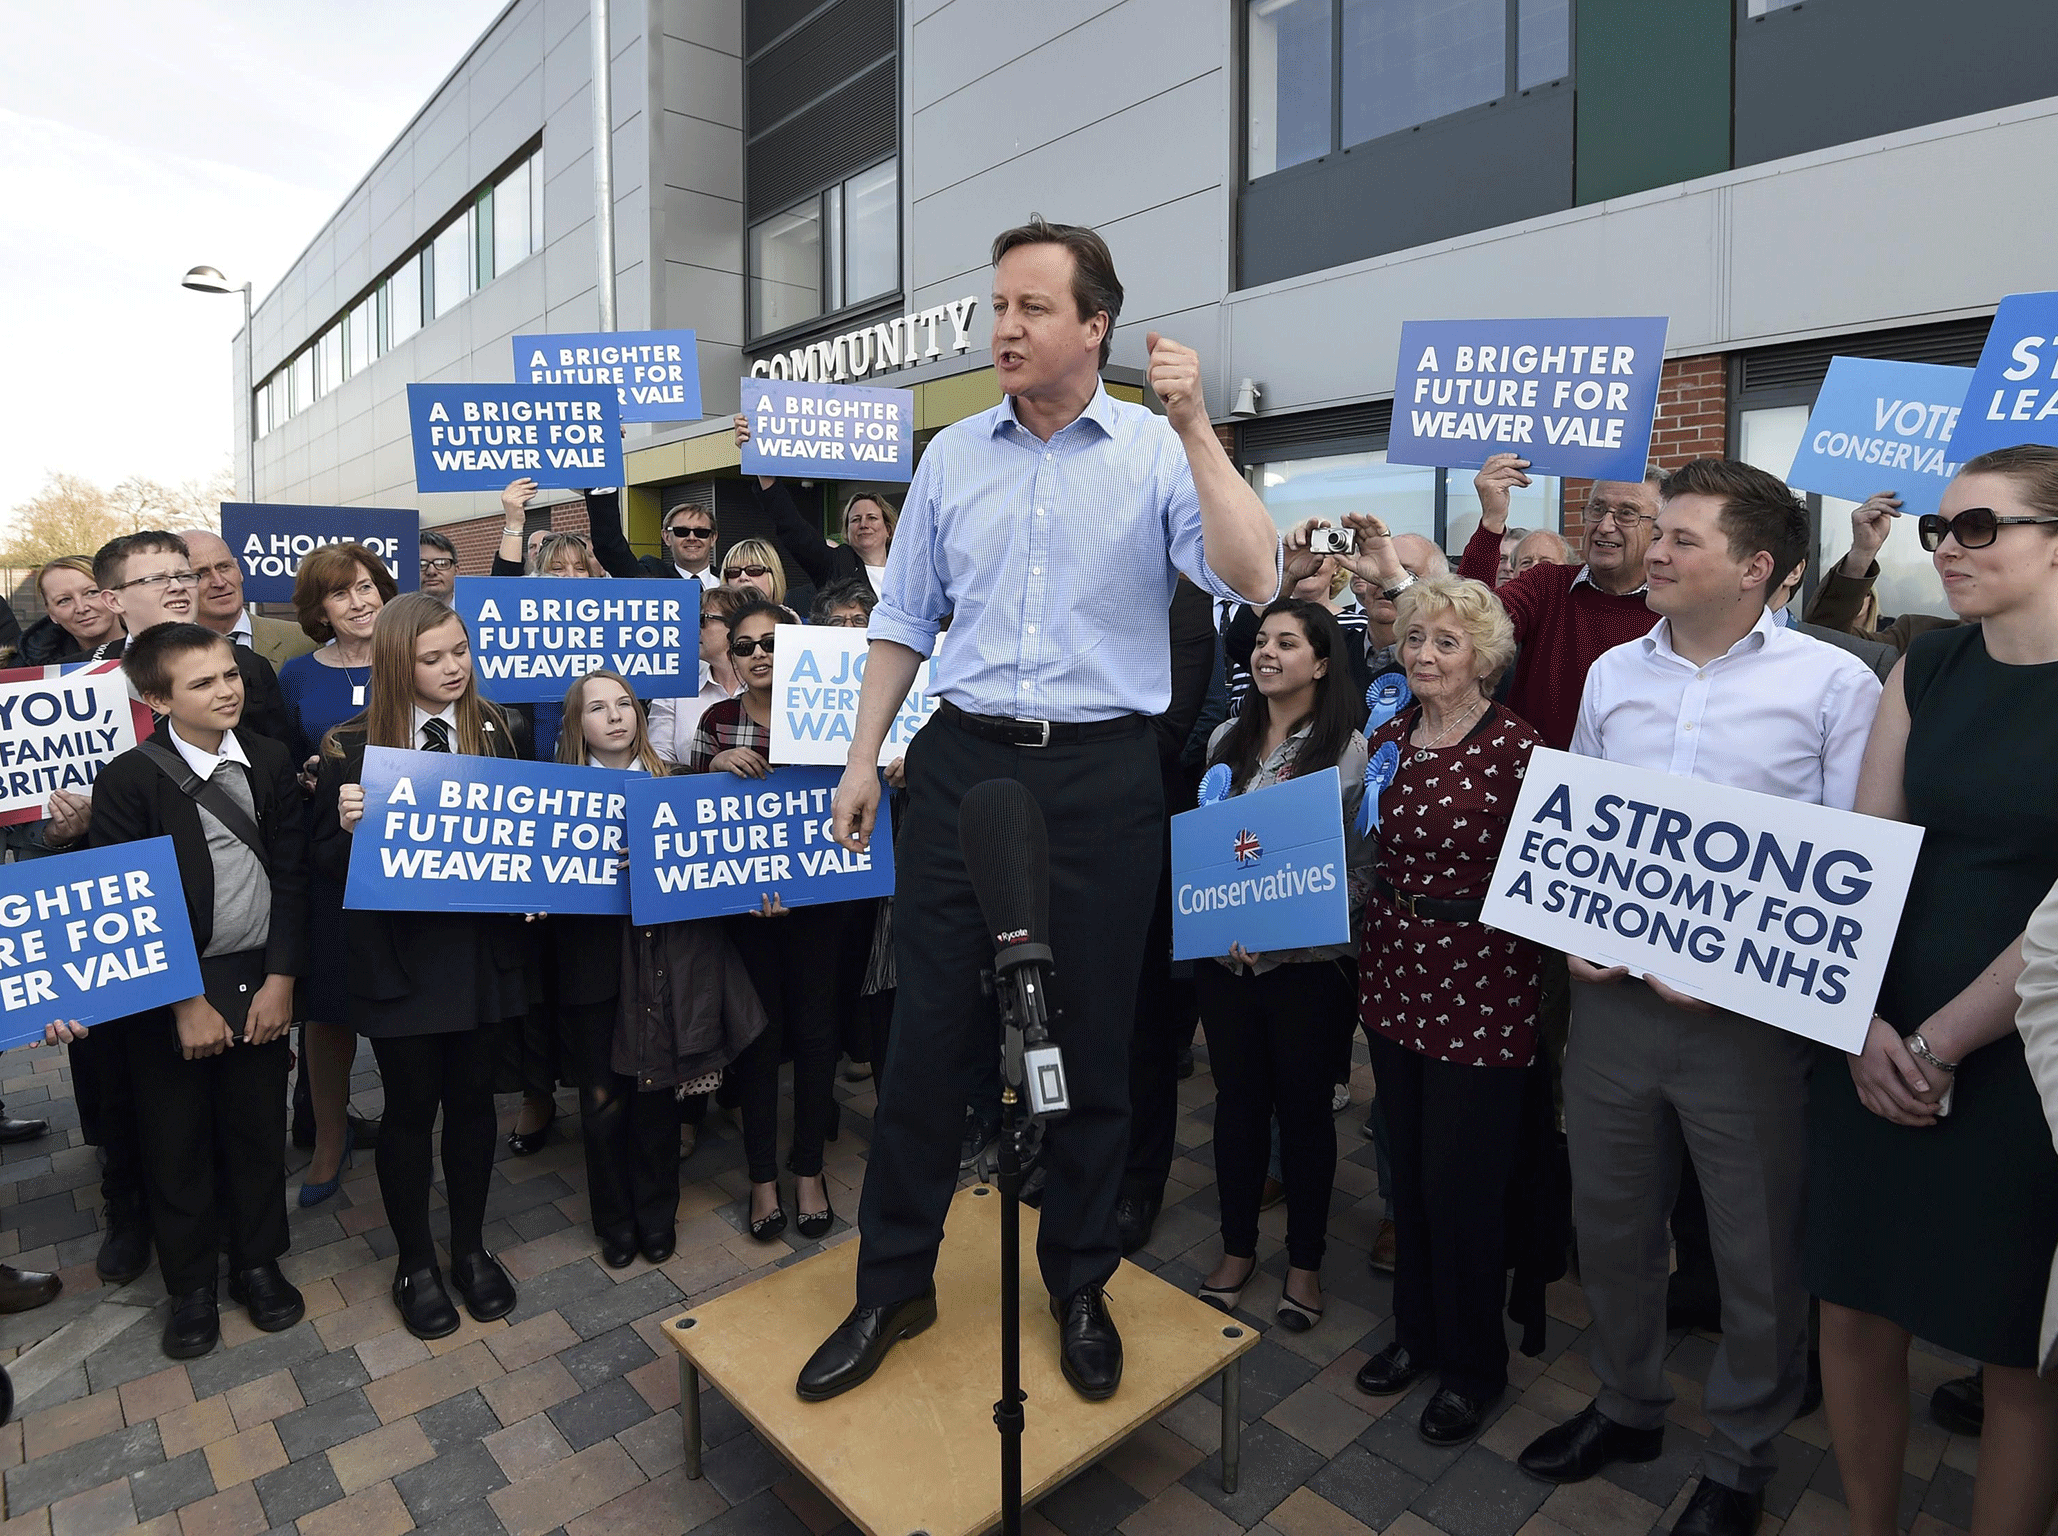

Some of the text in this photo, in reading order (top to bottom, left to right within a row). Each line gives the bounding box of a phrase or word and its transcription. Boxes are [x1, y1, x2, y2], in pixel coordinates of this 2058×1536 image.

[530, 345, 682, 367] A BRIGHTER
[751, 296, 978, 383] COMMUNITY
[532, 365, 683, 384] FUTURE FOR
[1417, 345, 1635, 375] A BRIGHTER
[631, 385, 685, 404] VALE
[757, 395, 899, 421] A BRIGHTER
[1414, 378, 1629, 411] FUTURE FOR
[429, 401, 603, 422] A BRIGHTER
[431, 424, 605, 446] FUTURE FOR
[757, 416, 899, 442] FUTURE FOR
[1411, 410, 1625, 448] WEAVER VALE
[432, 448, 606, 471] WEAVER VALE
[756, 438, 898, 463] WEAVER VALE
[1812, 430, 1964, 478] CONSERVA
[243, 533, 265, 555] A
[362, 538, 399, 558] OF
[243, 555, 303, 577] YOU
[478, 599, 681, 622] A BRIGHTER
[479, 626, 681, 650] FUTURE FOR
[478, 653, 680, 679] WEAVER VALE
[789, 650, 822, 683] A
[0, 687, 113, 731] YOU,
[786, 686, 934, 713] EVERNE
[786, 711, 922, 744] WATS
[0, 726, 119, 767] FAMILY
[387, 777, 626, 820] A BRIGHTER
[652, 787, 838, 829] A BRIGHT
[384, 811, 623, 851] FUTURE FOR
[654, 822, 789, 860] FUTURE
[1532, 783, 1873, 906] A STRONG
[380, 848, 619, 885] WEAVER VALE
[654, 846, 872, 893] WEAVER VALE
[0, 869, 156, 928] GHTER
[1178, 862, 1336, 916] Conservatives
[1518, 829, 1863, 960] ECONOMY FOR
[66, 905, 163, 953] FOR
[1505, 870, 1851, 1005] A STRONG NHS
[62, 940, 169, 992] VALE
